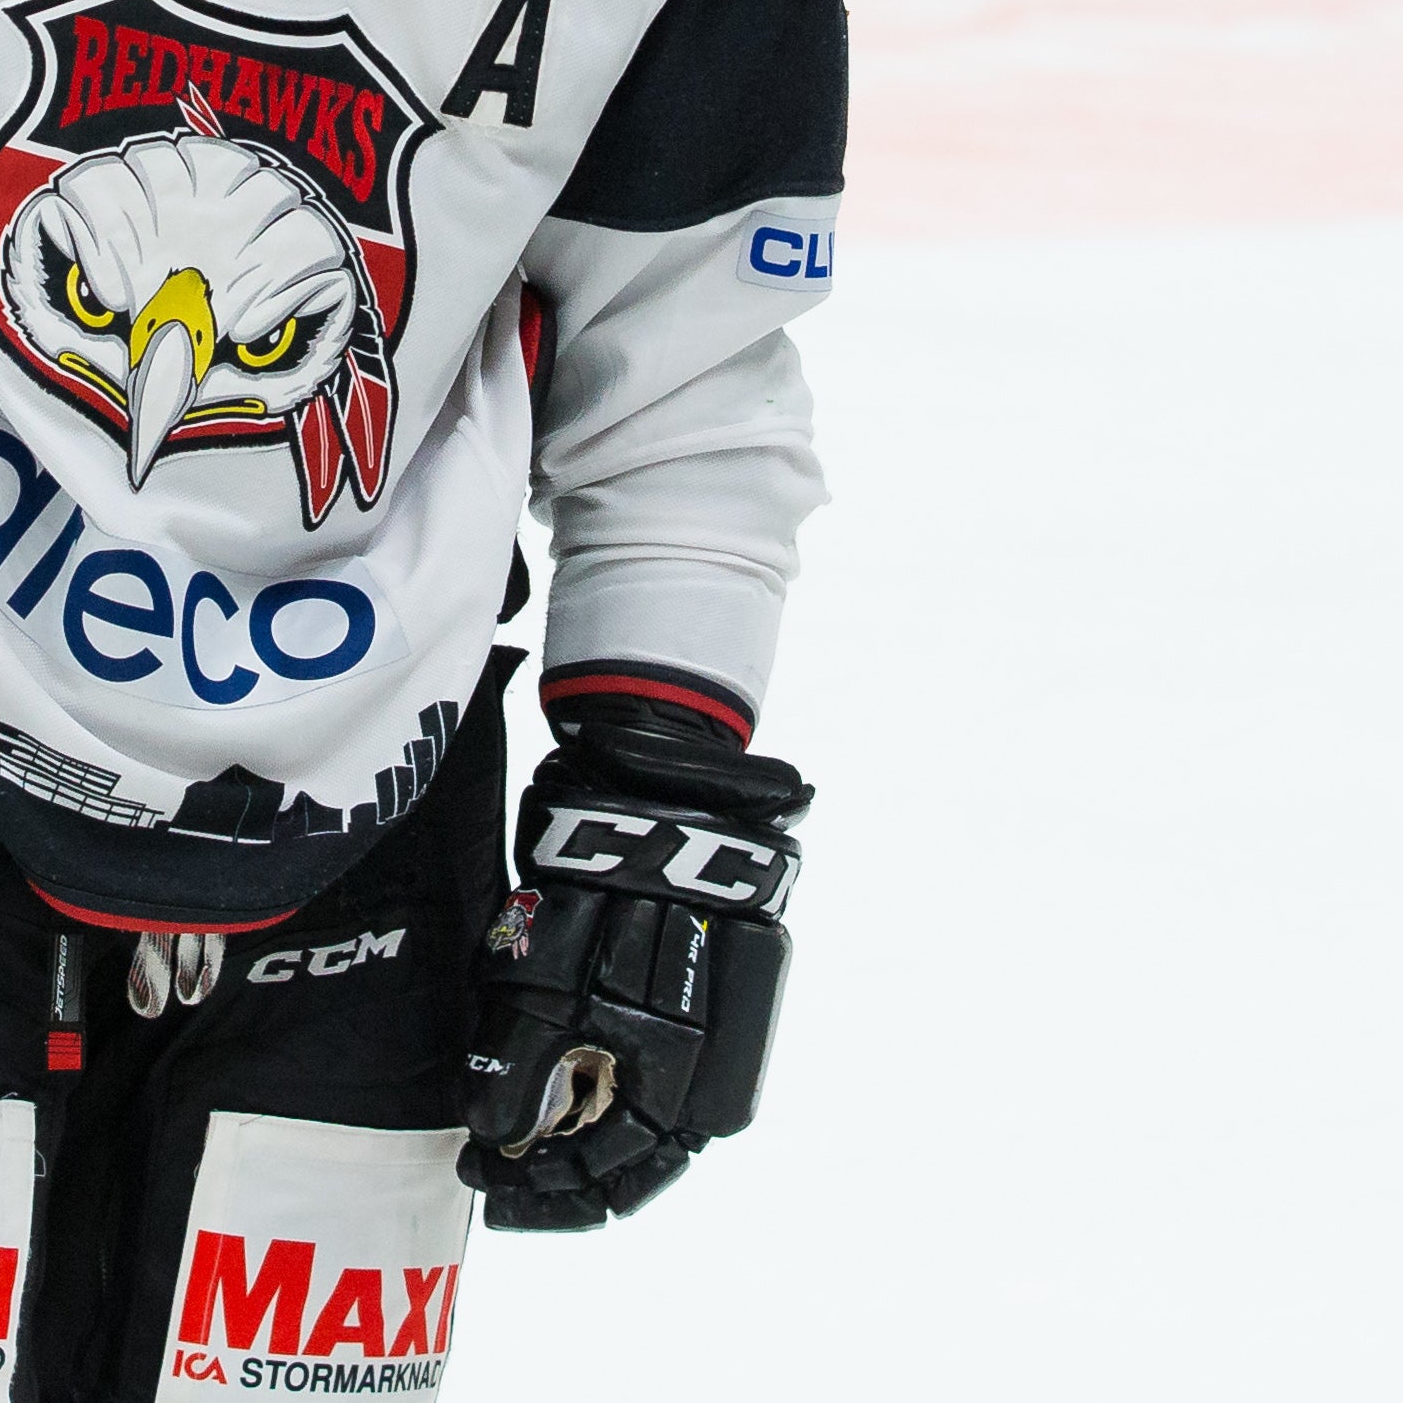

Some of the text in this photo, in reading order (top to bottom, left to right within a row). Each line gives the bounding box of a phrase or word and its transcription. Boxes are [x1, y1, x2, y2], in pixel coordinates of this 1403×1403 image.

[59, 13, 385, 204] REDHAWKS
[55, 934, 68, 1021] JETSPEED
[247, 928, 406, 984] CCM
[172, 1349, 227, 1385] ICA
